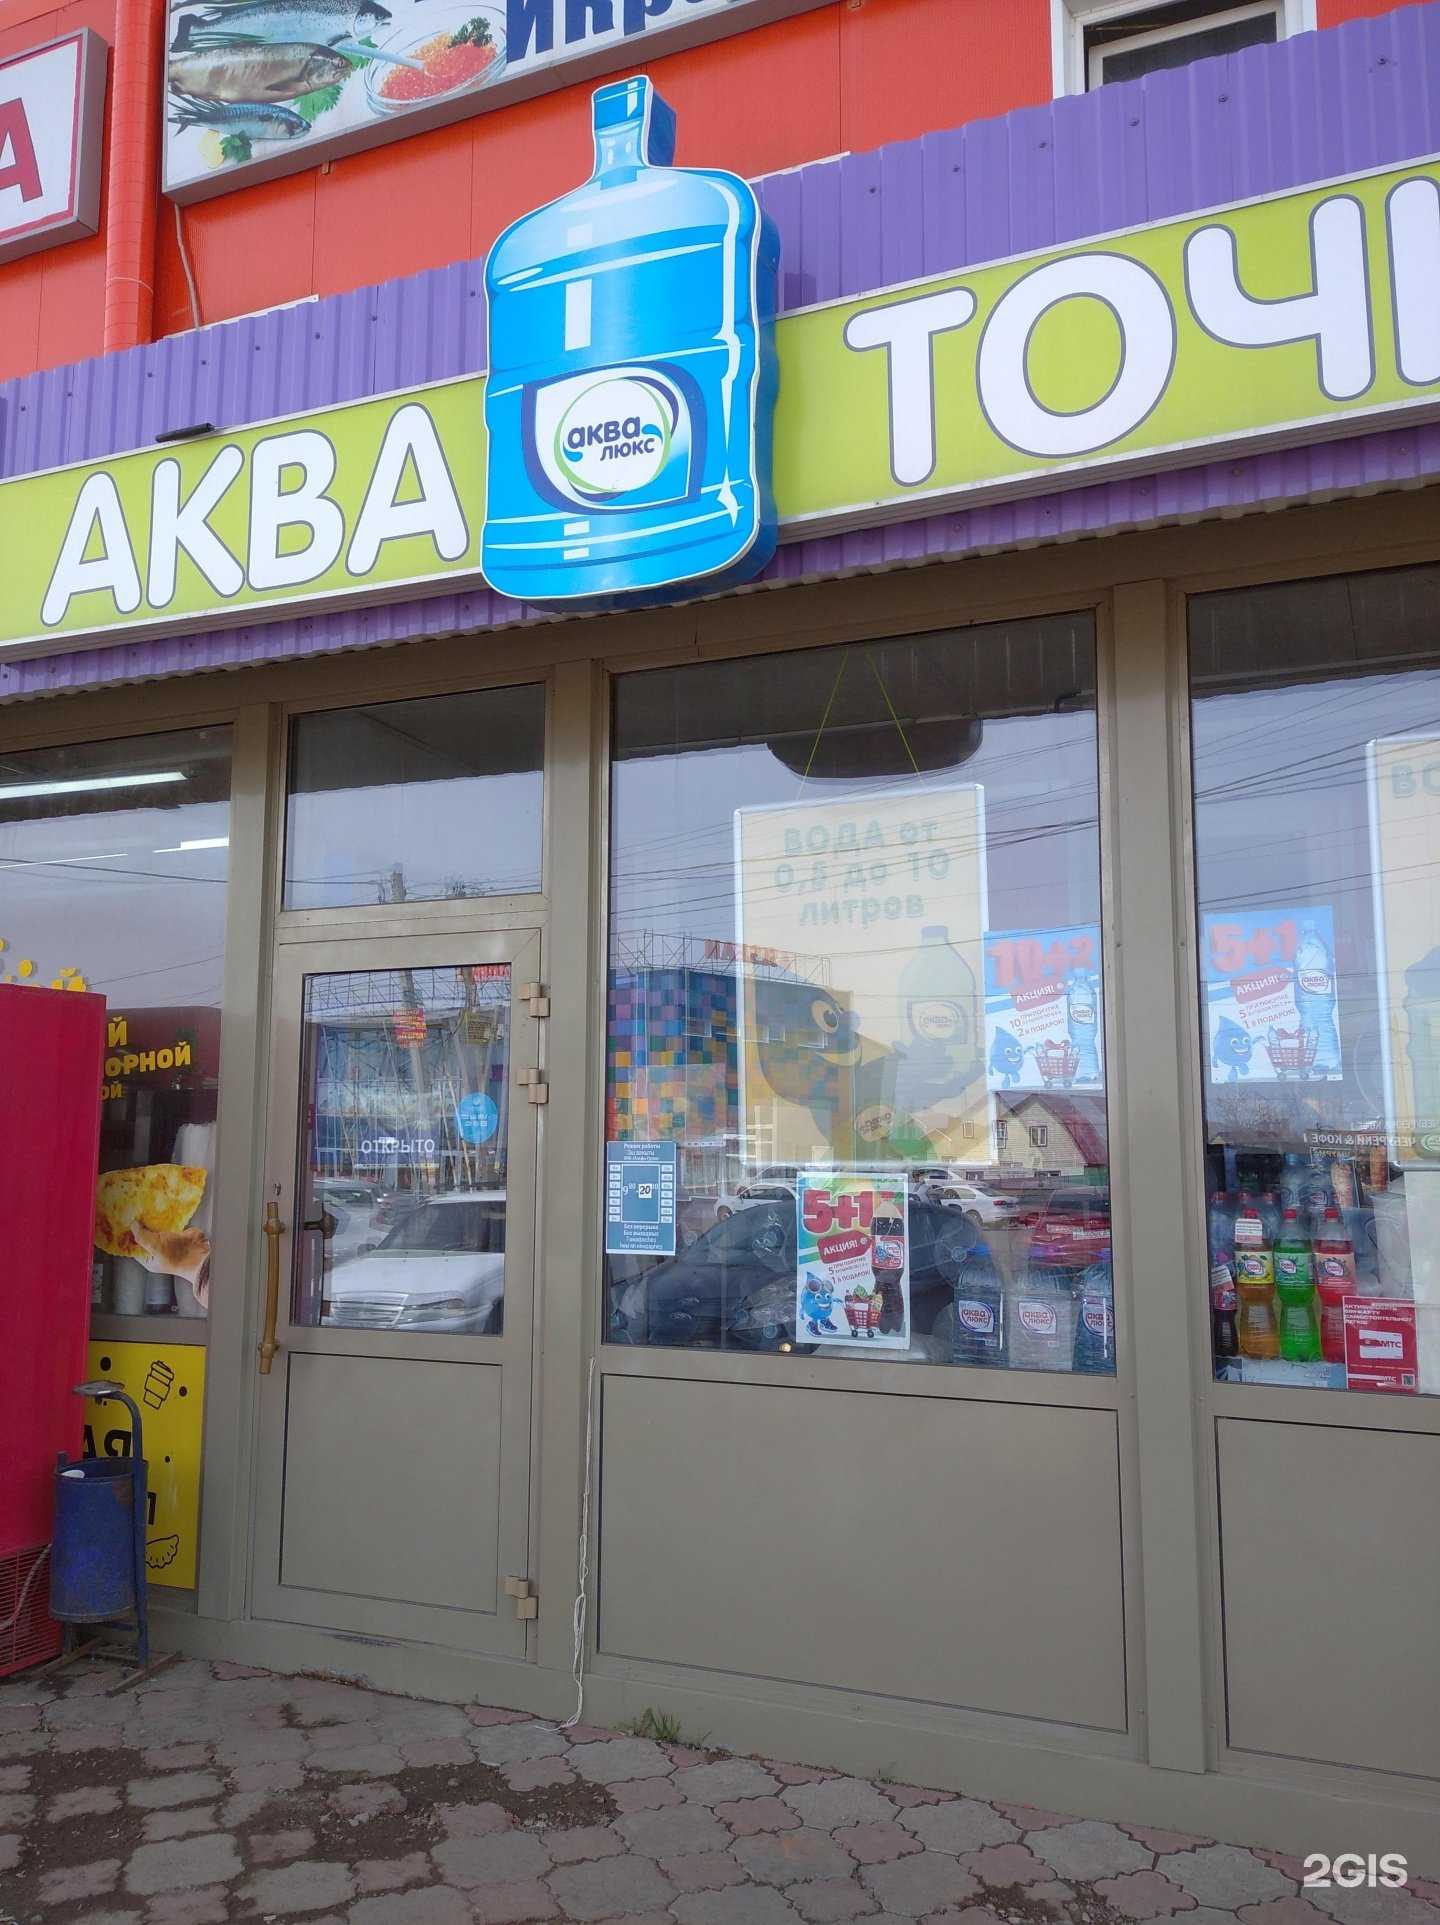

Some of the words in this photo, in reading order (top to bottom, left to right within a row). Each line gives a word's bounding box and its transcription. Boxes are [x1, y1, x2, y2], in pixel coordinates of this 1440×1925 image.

[42, 403, 469, 626] АКВА
[784, 820, 884, 859] ВОДА
[800, 894, 925, 928] литров
[1211, 920, 1297, 972] 5+1
[1015, 984, 1055, 1004] АКЦИЯ!
[1236, 974, 1279, 996] АКЦИЯ!
[105, 1041, 191, 1077] ОРНОЙ
[361, 1139, 435, 1153] ОТКРЫТО
[639, 1185, 650, 1195] 20
[803, 1190, 873, 1233] 5+1
[823, 1240, 858, 1256] АКЦИЯ!
